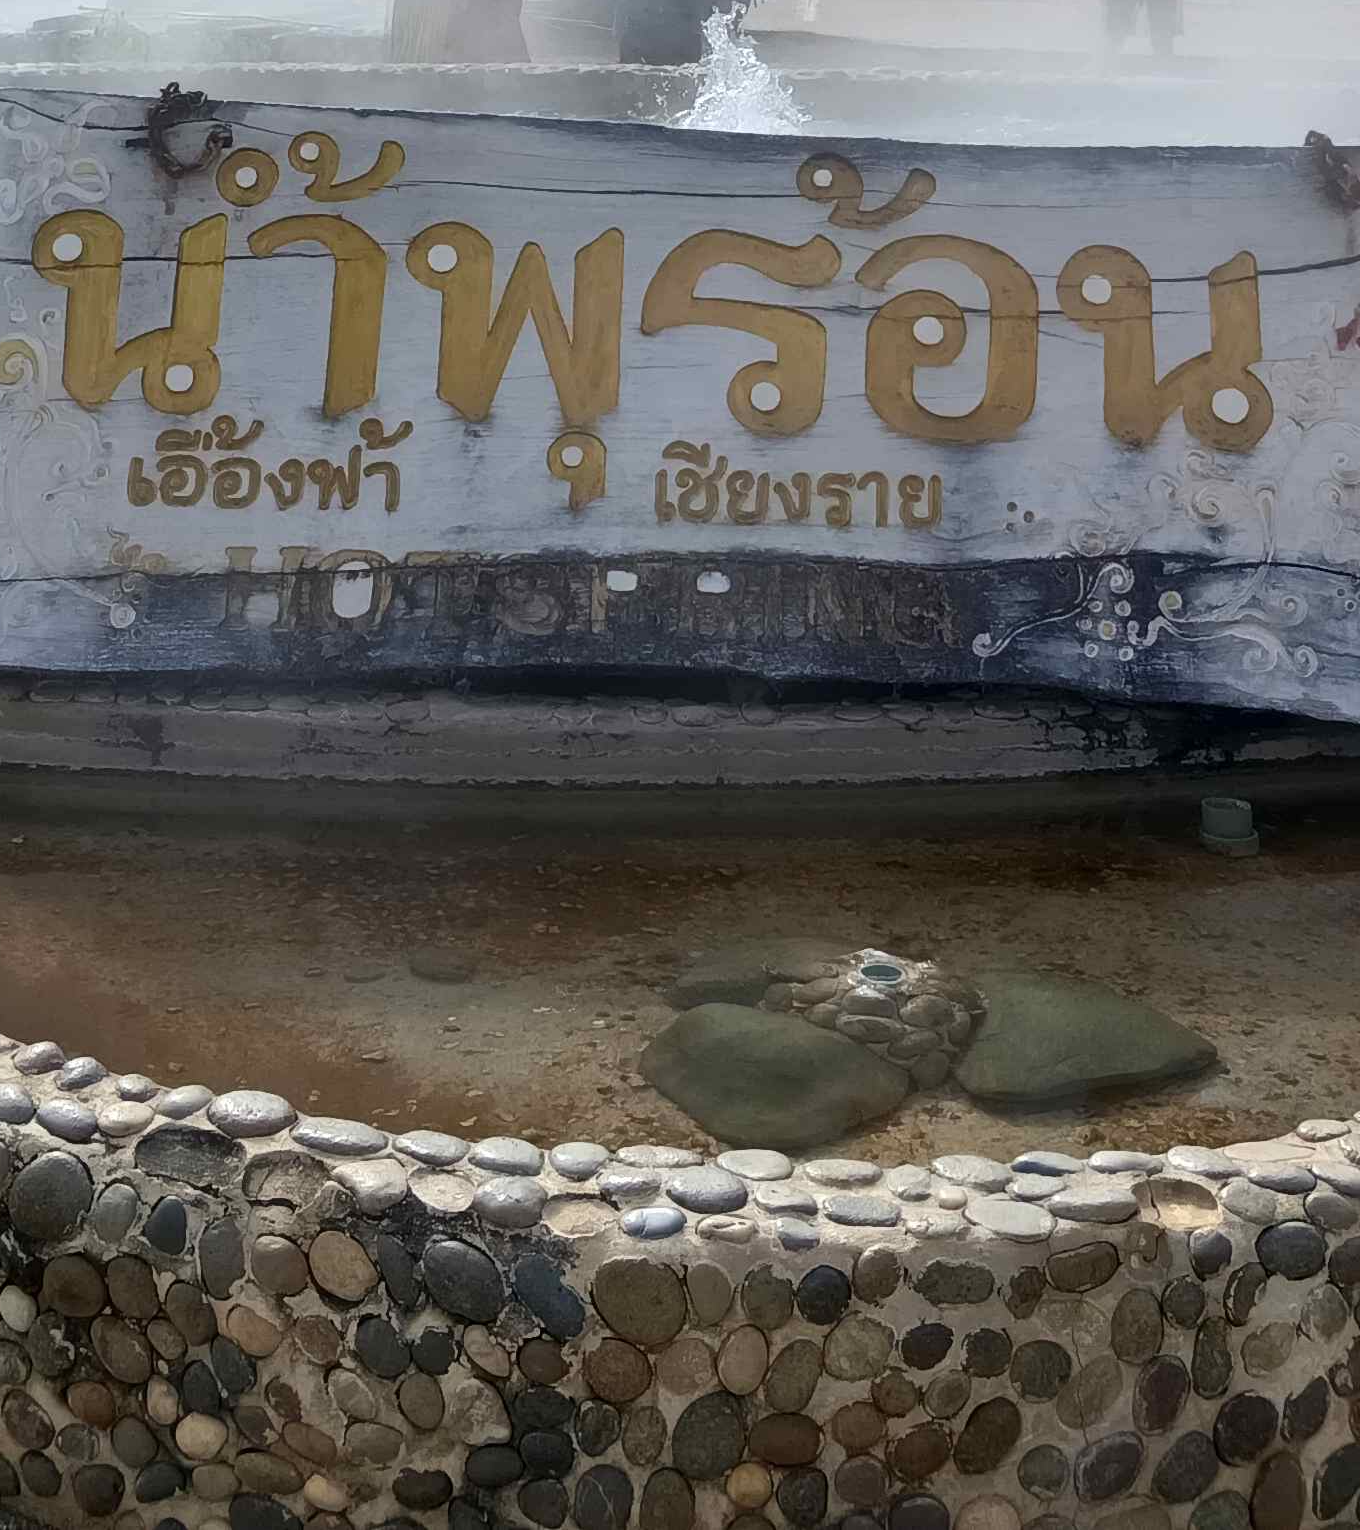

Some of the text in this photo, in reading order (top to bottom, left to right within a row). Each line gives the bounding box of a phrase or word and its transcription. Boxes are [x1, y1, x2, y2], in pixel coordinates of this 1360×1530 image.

[31, 131, 1274, 512] น้ำพุร้อน
[654, 440, 943, 528] เชียงราย
[219, 545, 486, 632] HOT
